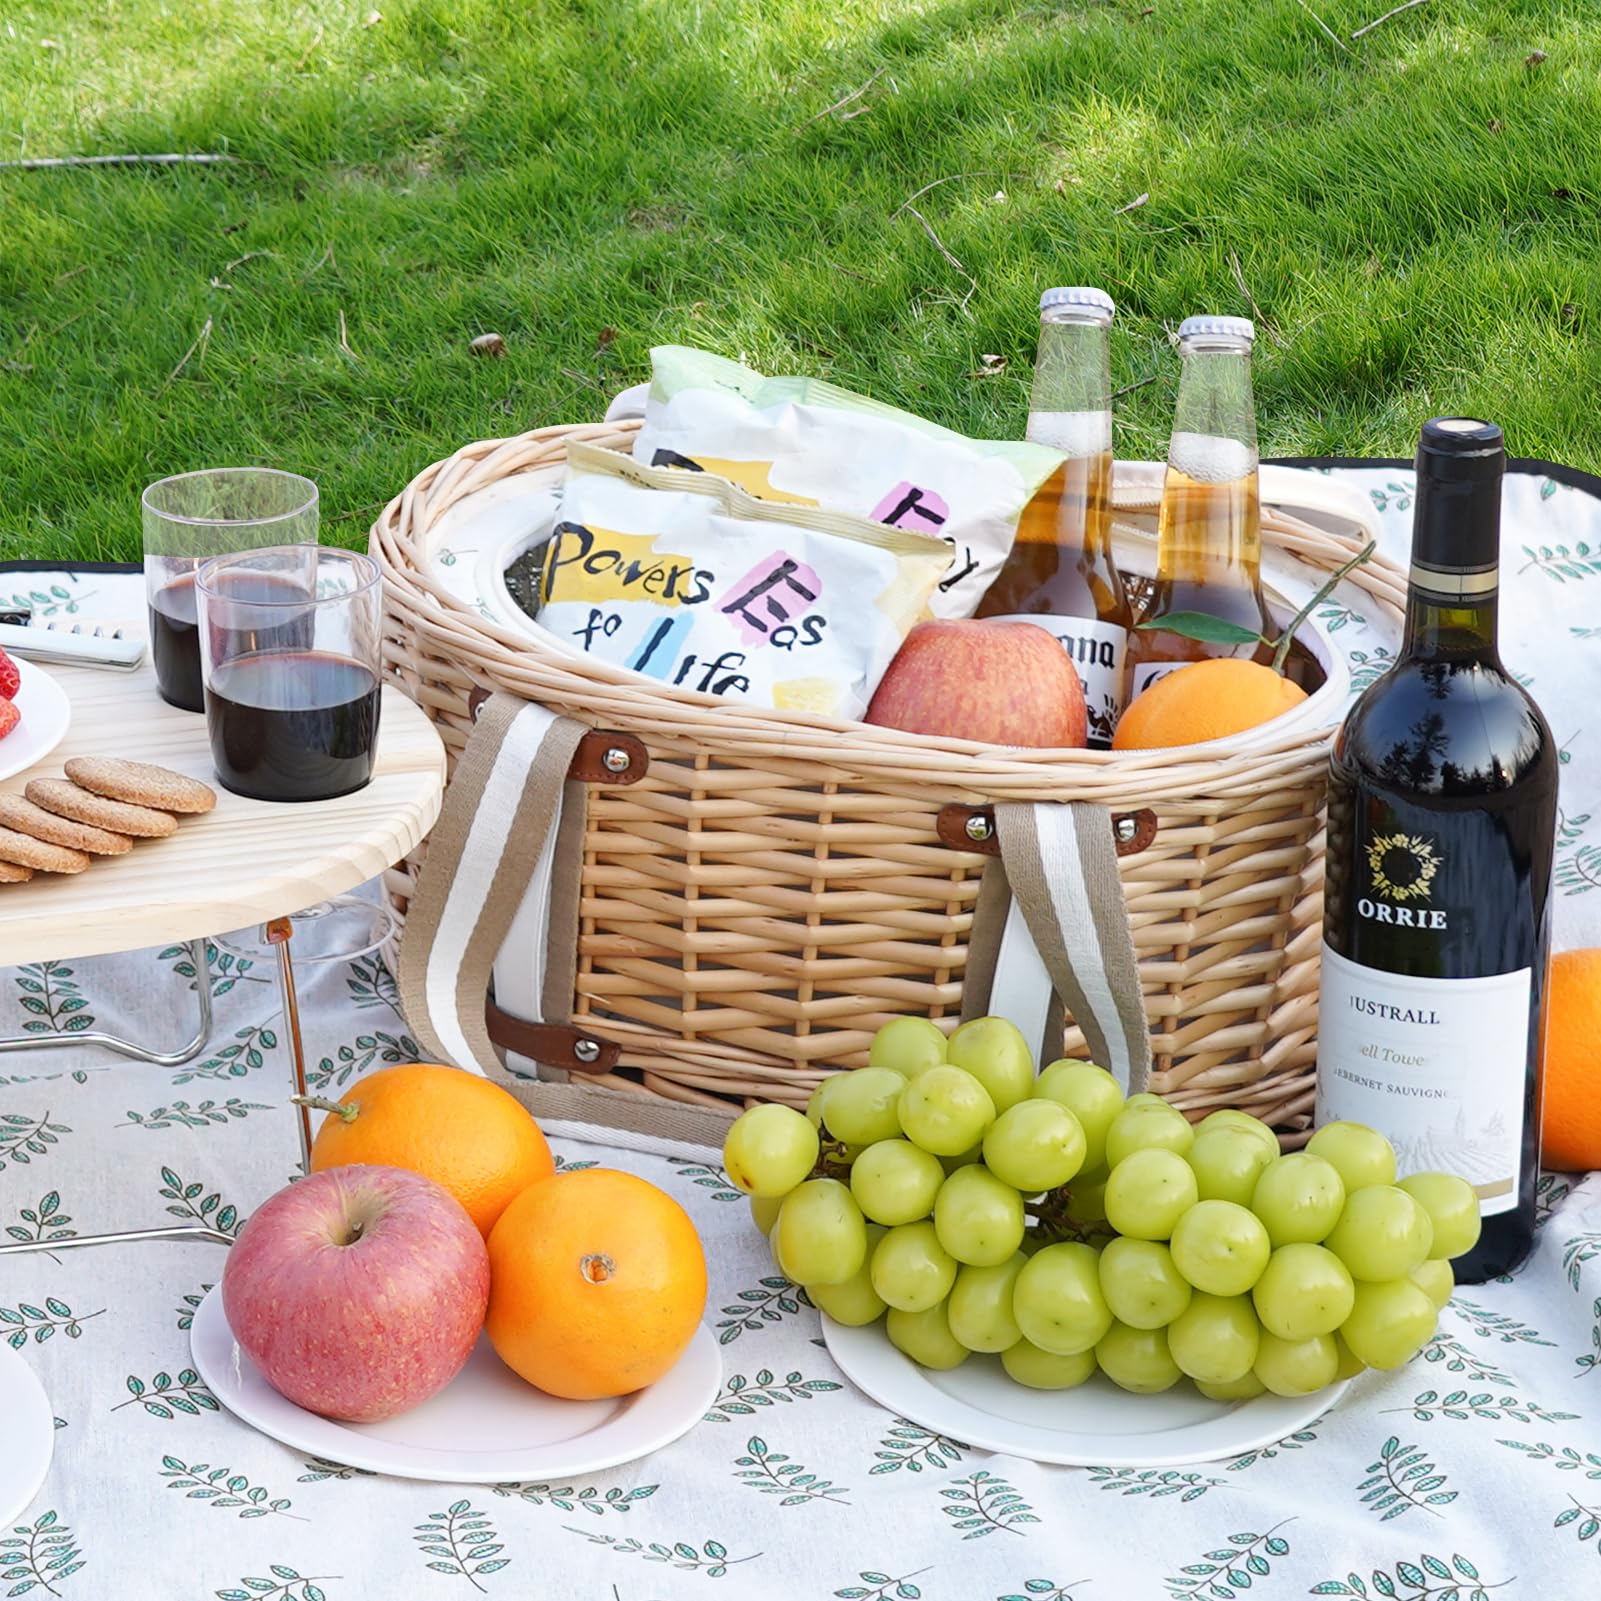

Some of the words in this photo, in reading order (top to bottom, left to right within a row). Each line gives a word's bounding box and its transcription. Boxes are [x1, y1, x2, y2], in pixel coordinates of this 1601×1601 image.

[545, 521, 715, 604] Powers
[1357, 898, 1448, 930] ORRIE
[1360, 1043, 1379, 1060] ell
